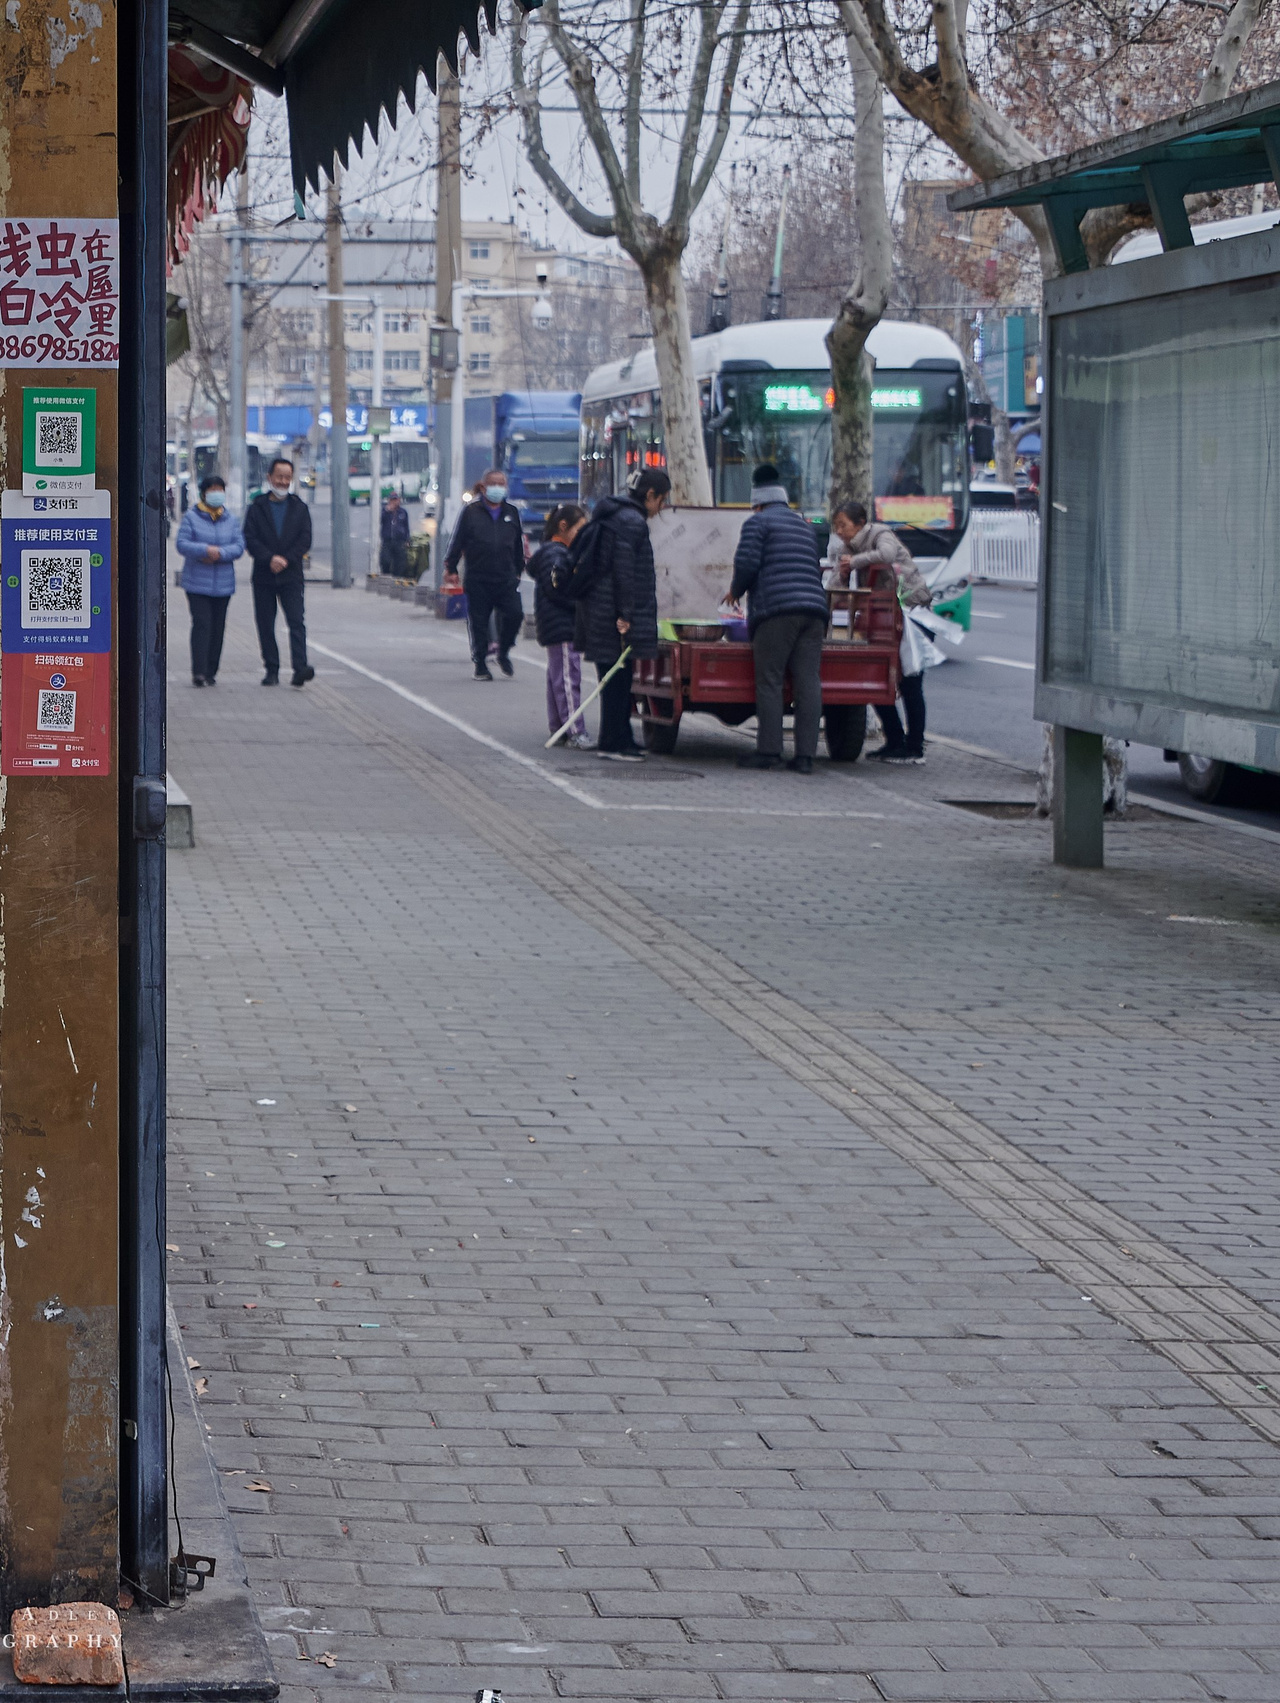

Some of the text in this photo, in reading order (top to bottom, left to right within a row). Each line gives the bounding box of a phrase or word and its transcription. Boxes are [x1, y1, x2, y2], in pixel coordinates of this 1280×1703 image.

[81, 228, 118, 338] 在屋里
[49, 481, 82, 489] 微信支付
[48, 498, 78, 510] 支付宝
[14, 528, 98, 541] 推荐使用支付宝
[23, 635, 89, 643] 支付得蚂蚁森林能量
[35, 654, 84, 666] 扫码领红包
